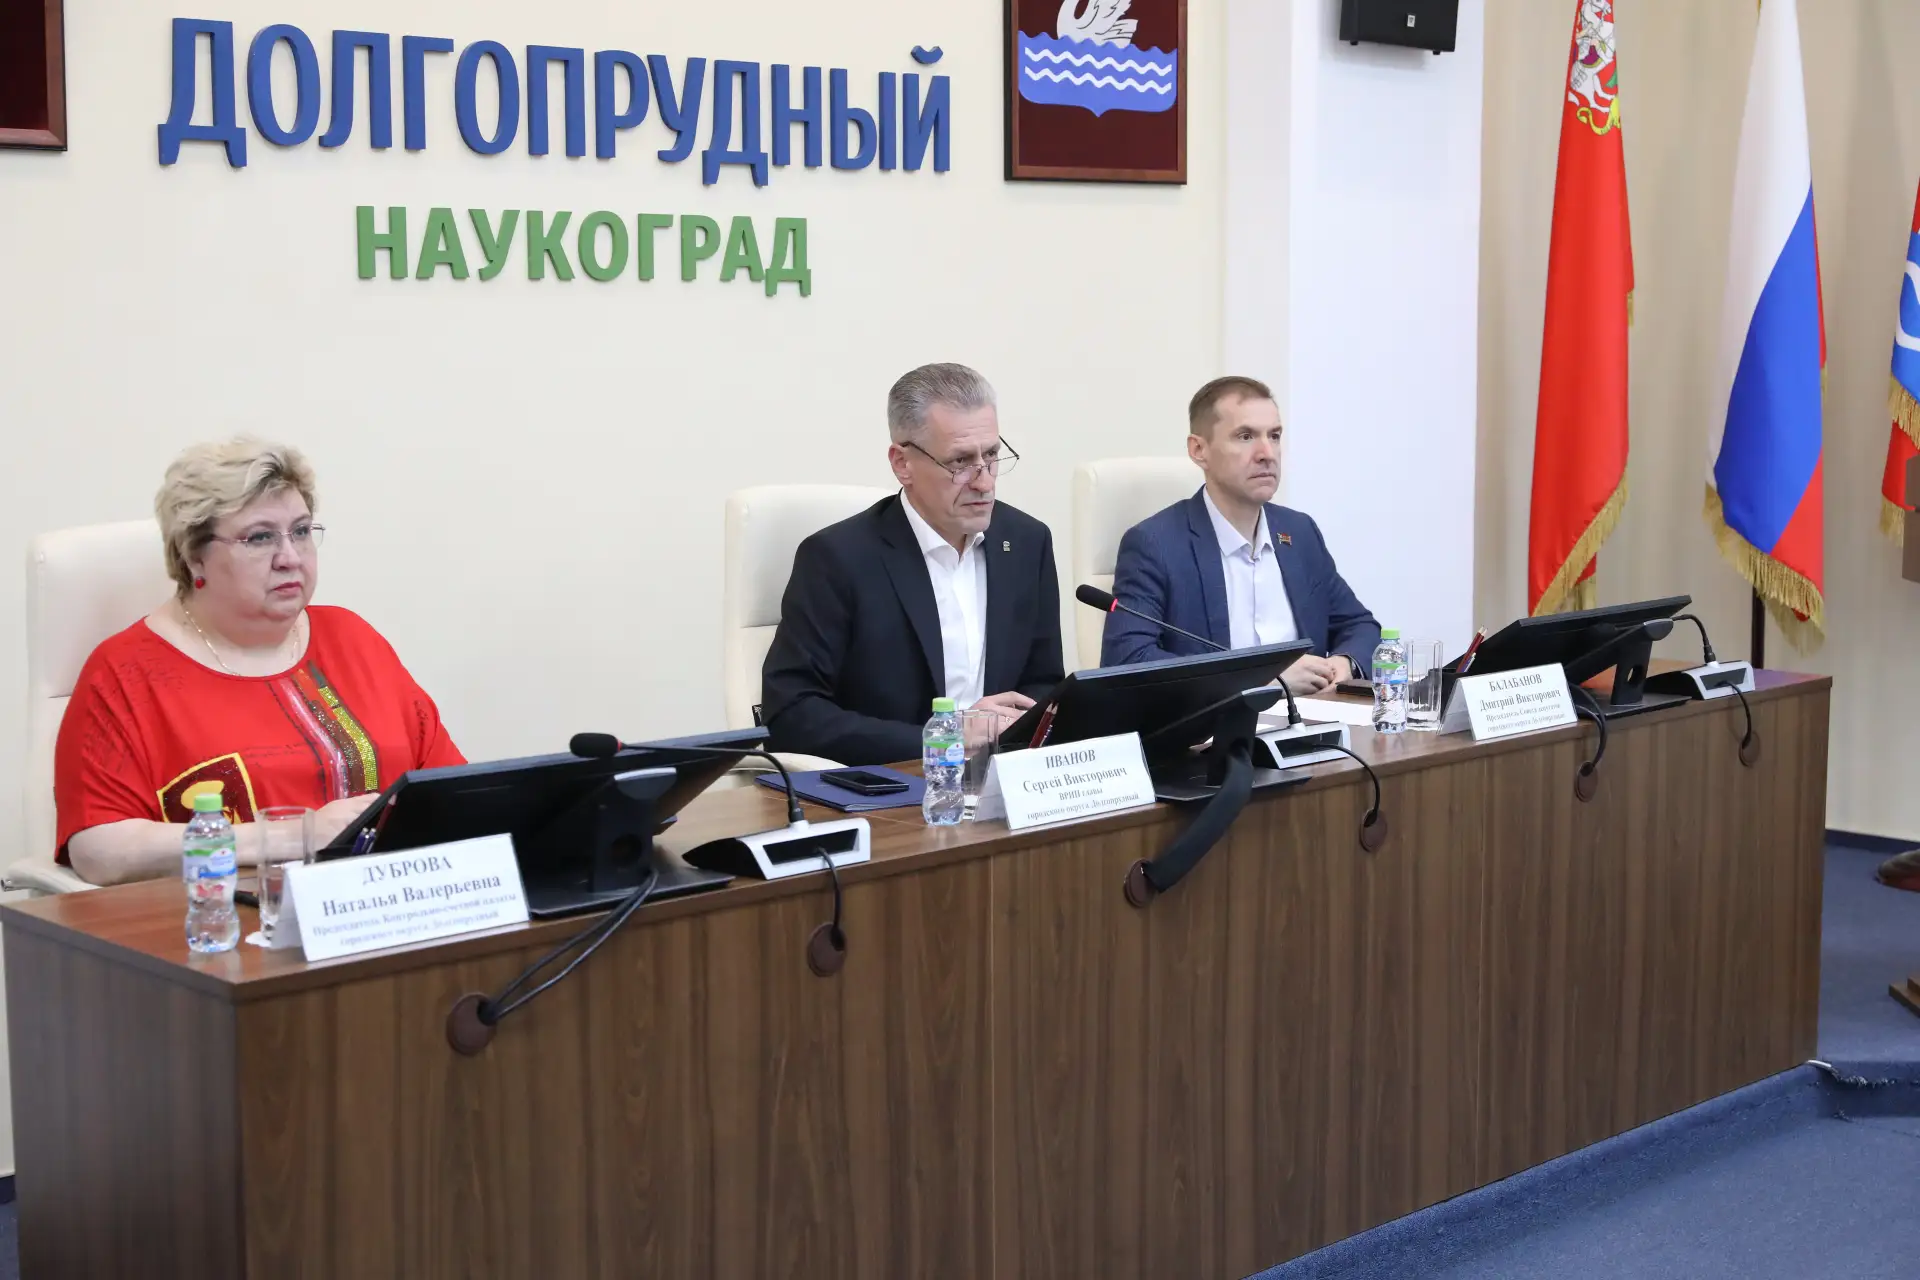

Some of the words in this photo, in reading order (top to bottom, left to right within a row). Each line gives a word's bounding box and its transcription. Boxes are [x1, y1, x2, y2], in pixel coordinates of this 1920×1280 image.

[158, 17, 950, 187] ДОЛГОПРУДНЫЙ
[356, 206, 812, 296] НАУКОГРАД
[1489, 674, 1542, 692] БАЛАБАНОВ
[1480, 695, 1515, 712] Дмитрий
[1516, 689, 1561, 704] Викторович
[1045, 749, 1096, 769] ИВАНОВ
[1023, 775, 1062, 794] Сергей
[1064, 767, 1128, 786] Викторович
[1059, 790, 1081, 801] ВРИП
[1082, 786, 1103, 799] главы
[1027, 807, 1066, 821] городского
[1066, 802, 1090, 816] округа
[1091, 793, 1140, 811] Долгопрудный
[362, 855, 453, 885] ДУБРОВА
[322, 891, 398, 917] Наталья
[402, 875, 502, 900] Валерьевна
